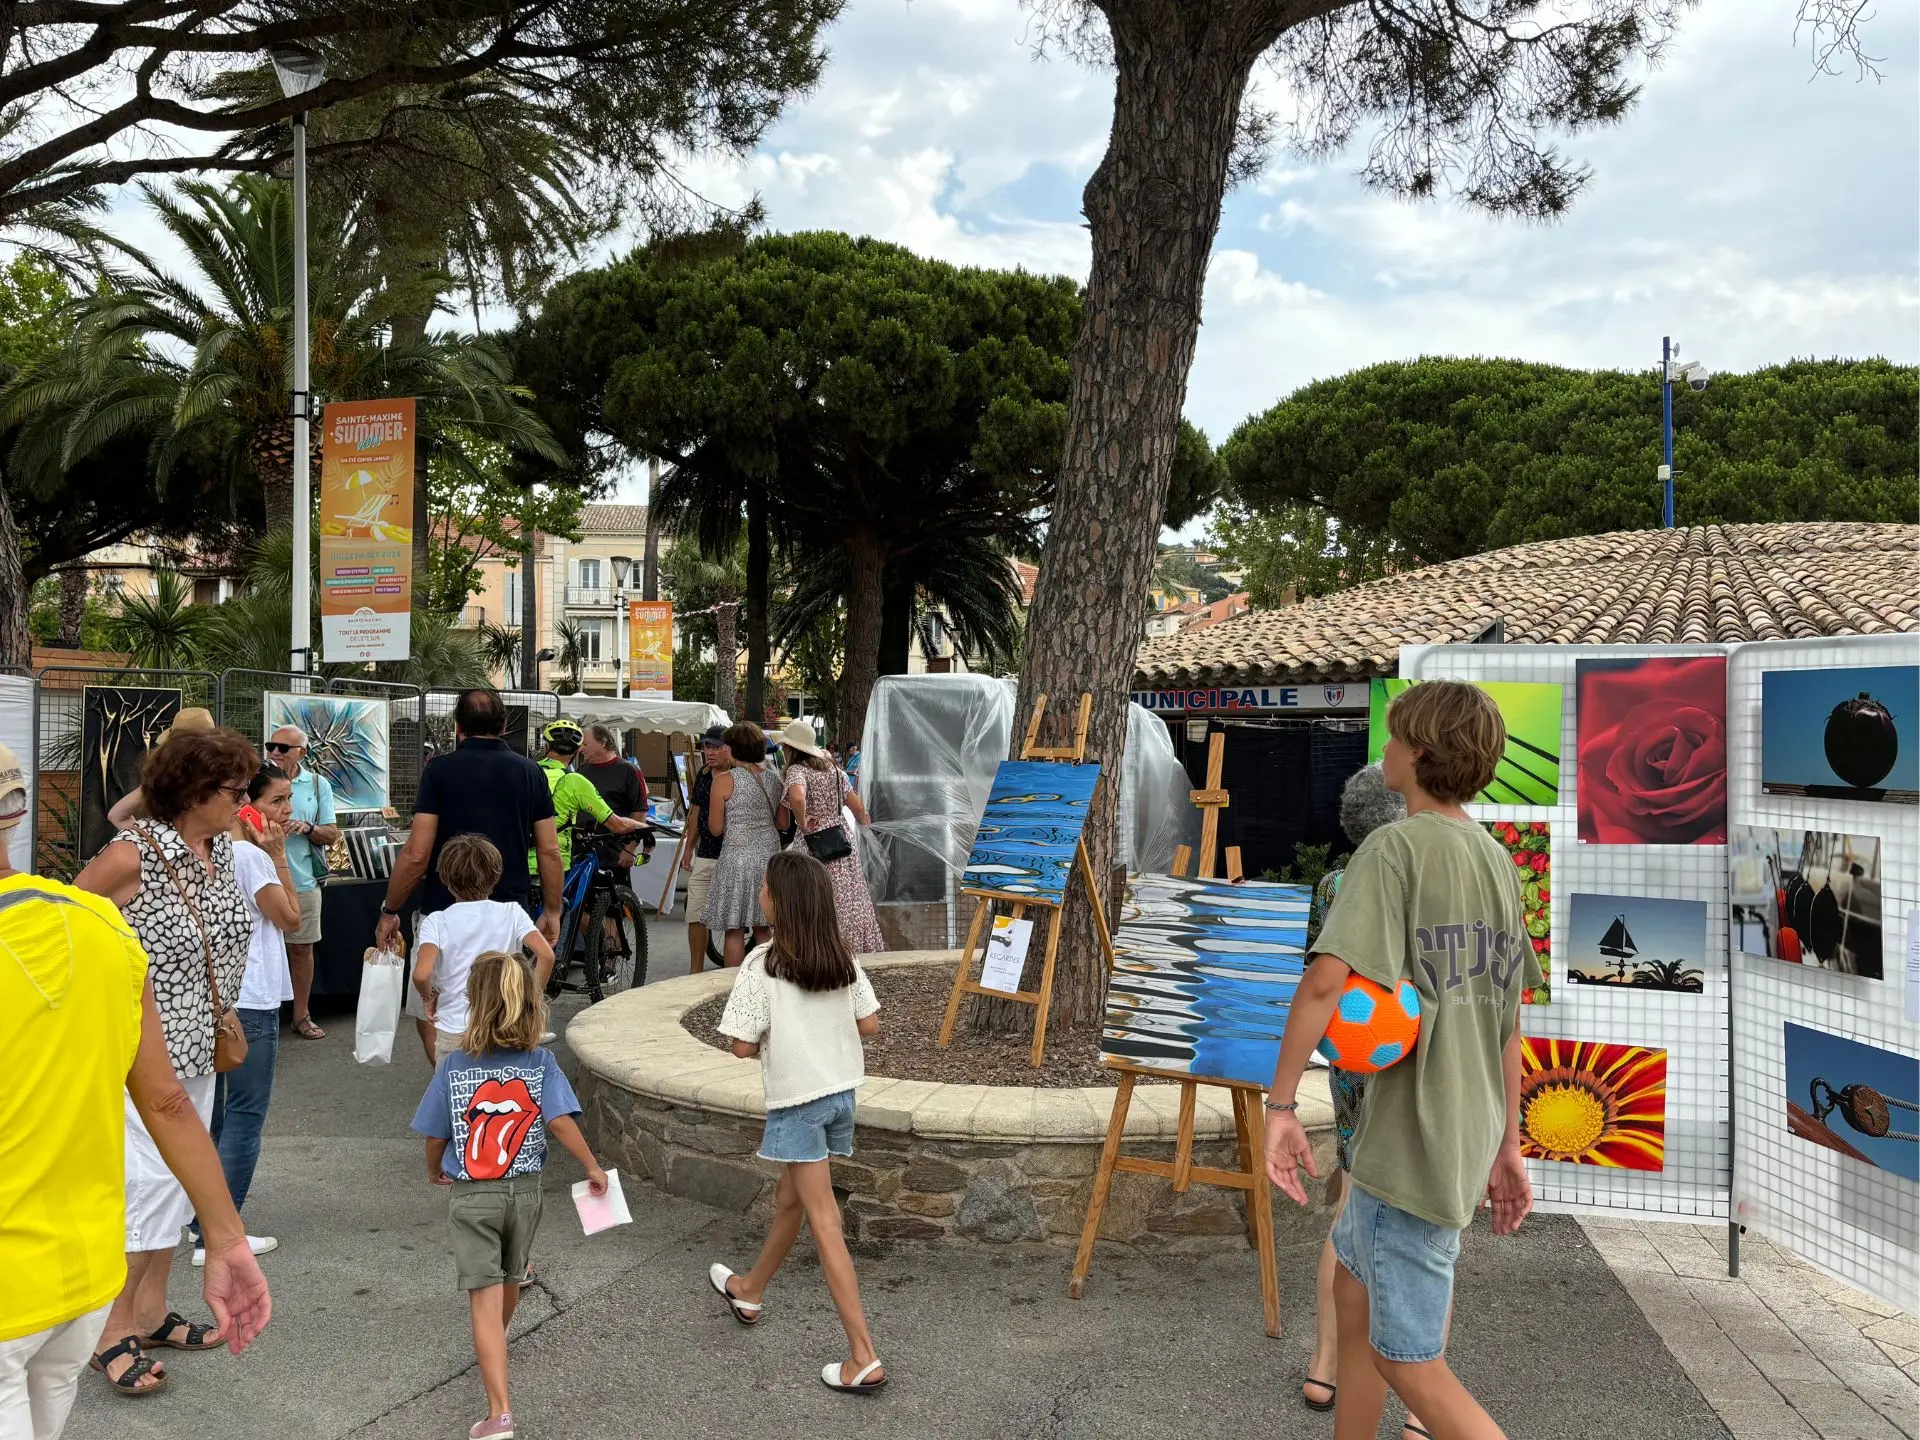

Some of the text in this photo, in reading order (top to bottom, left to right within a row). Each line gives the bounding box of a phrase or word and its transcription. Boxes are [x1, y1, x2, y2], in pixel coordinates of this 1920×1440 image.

[336, 413, 403, 425] SAINTE-MAXIME
[335, 422, 403, 444] SUMMER
[989, 952, 1021, 964] REGARDER
[449, 1065, 546, 1082] Rolling Stones
